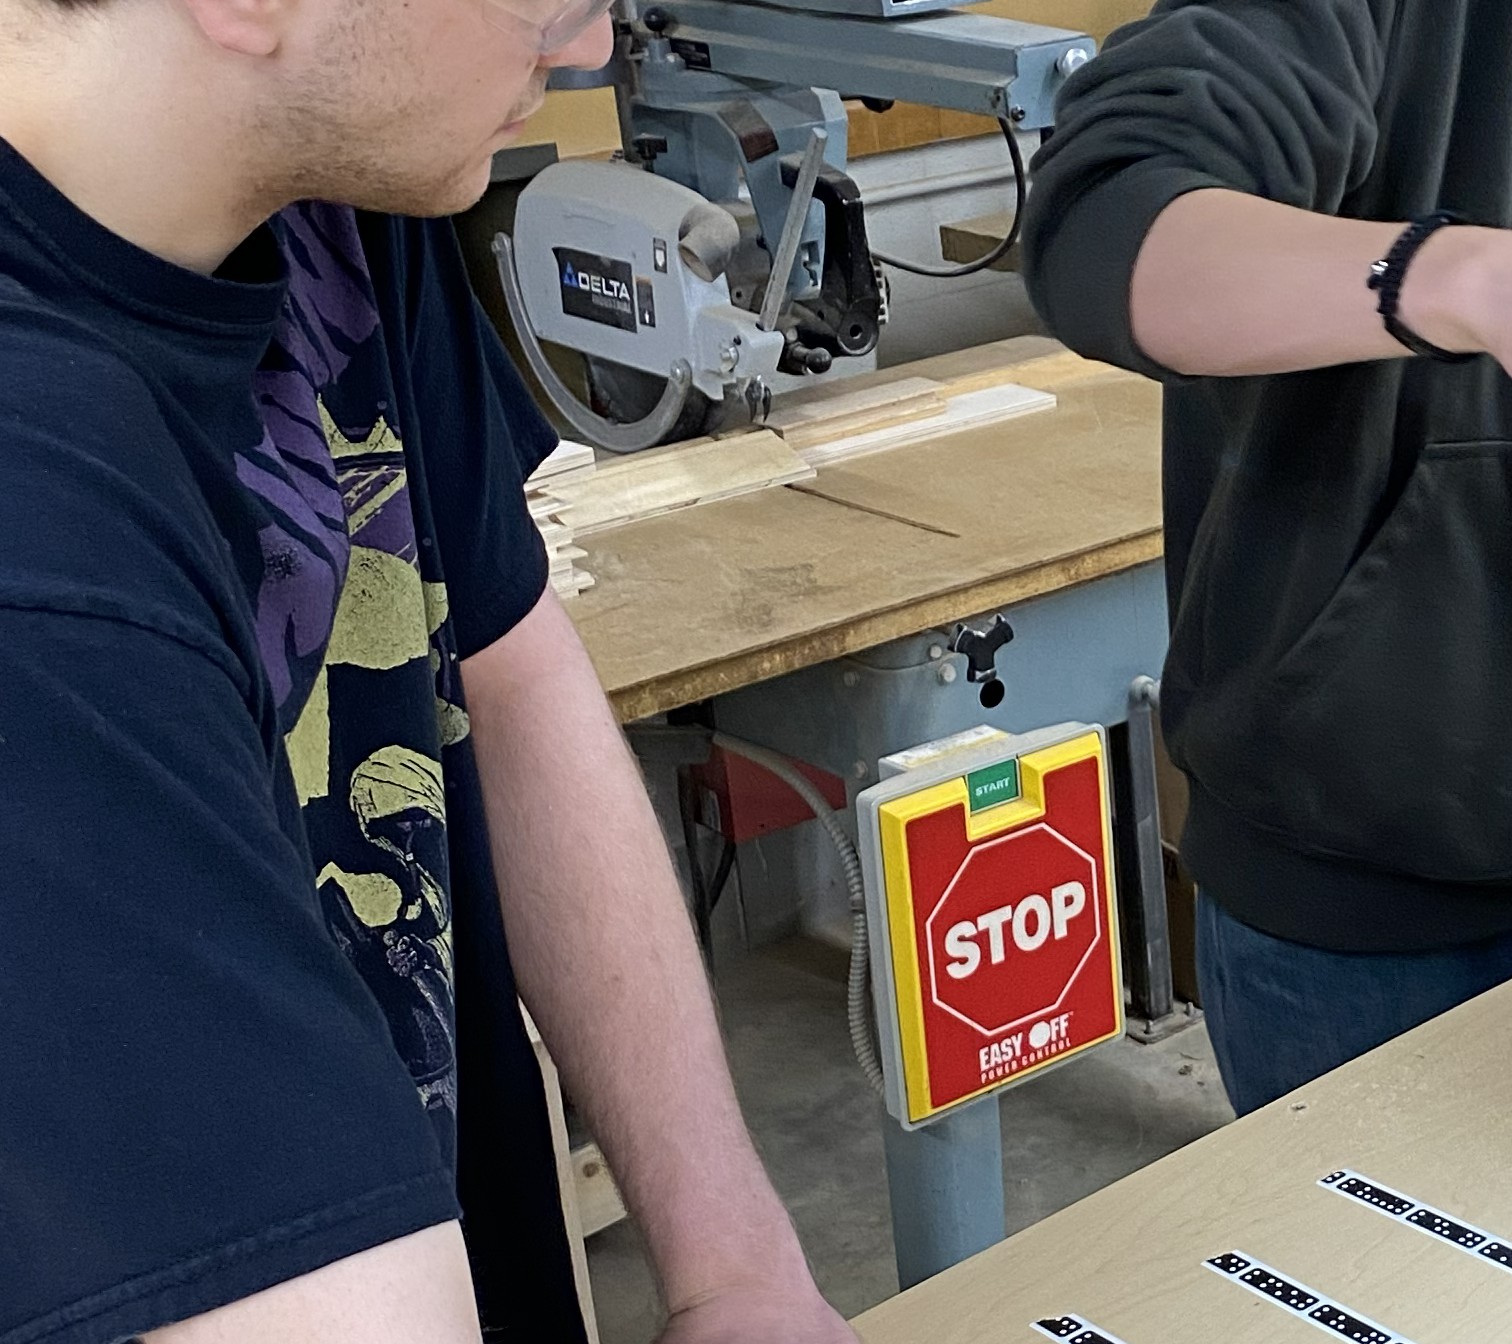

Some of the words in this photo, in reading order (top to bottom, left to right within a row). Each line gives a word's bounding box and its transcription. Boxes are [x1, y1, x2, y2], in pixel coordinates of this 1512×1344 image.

[578, 271, 631, 301] DELTA
[975, 776, 1011, 797] START
[944, 881, 1087, 980] STOP
[979, 1032, 1023, 1072] EASY
[980, 1060, 1018, 1084] POWER
[1021, 1037, 1071, 1067] CONTROL
